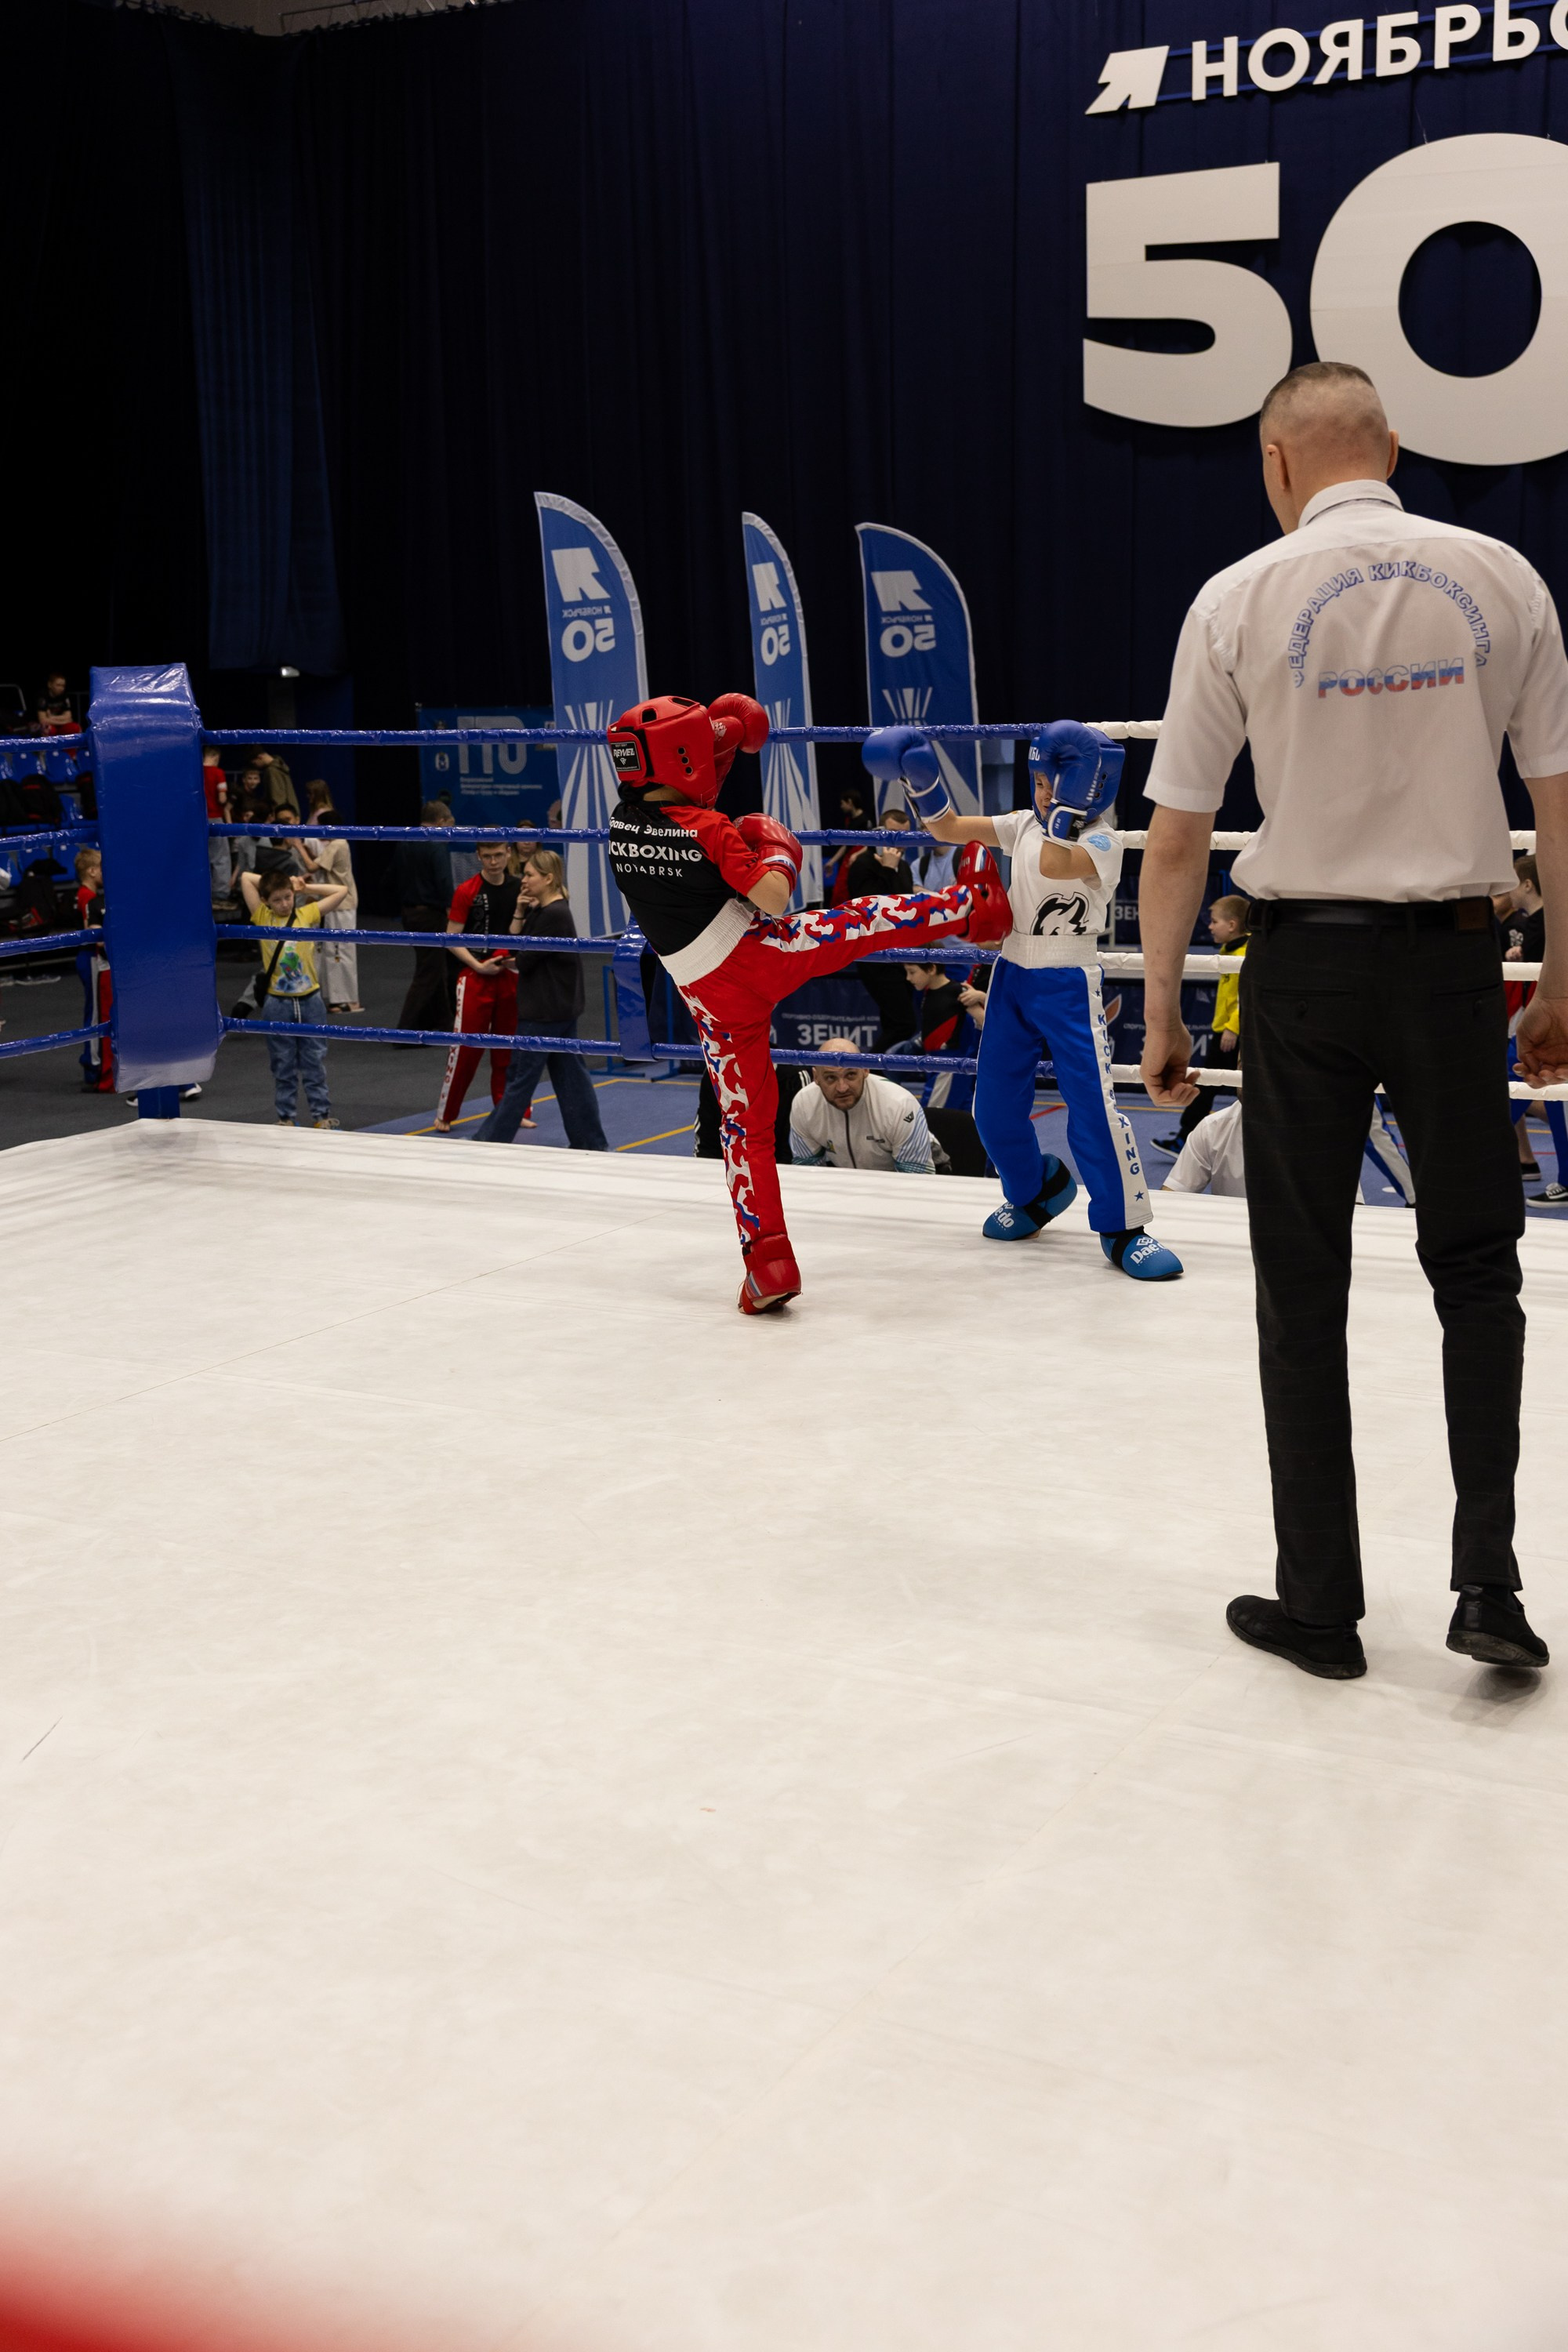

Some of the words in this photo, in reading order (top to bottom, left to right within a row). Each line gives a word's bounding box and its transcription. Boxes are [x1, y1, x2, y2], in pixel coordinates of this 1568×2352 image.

[1083, 132, 1568, 466] 50
[1288, 568, 1364, 688] ФЕДЕРАЦИЯ
[1368, 561, 1490, 667] КИКБОКСИНГА
[1318, 657, 1464, 699] РОССИИ
[608, 840, 702, 862] ICKBOXING
[643, 824, 698, 837] Эвелина
[797, 1023, 878, 1047] ЗЕНИТ
[1098, 1014, 1112, 1075] KICK
